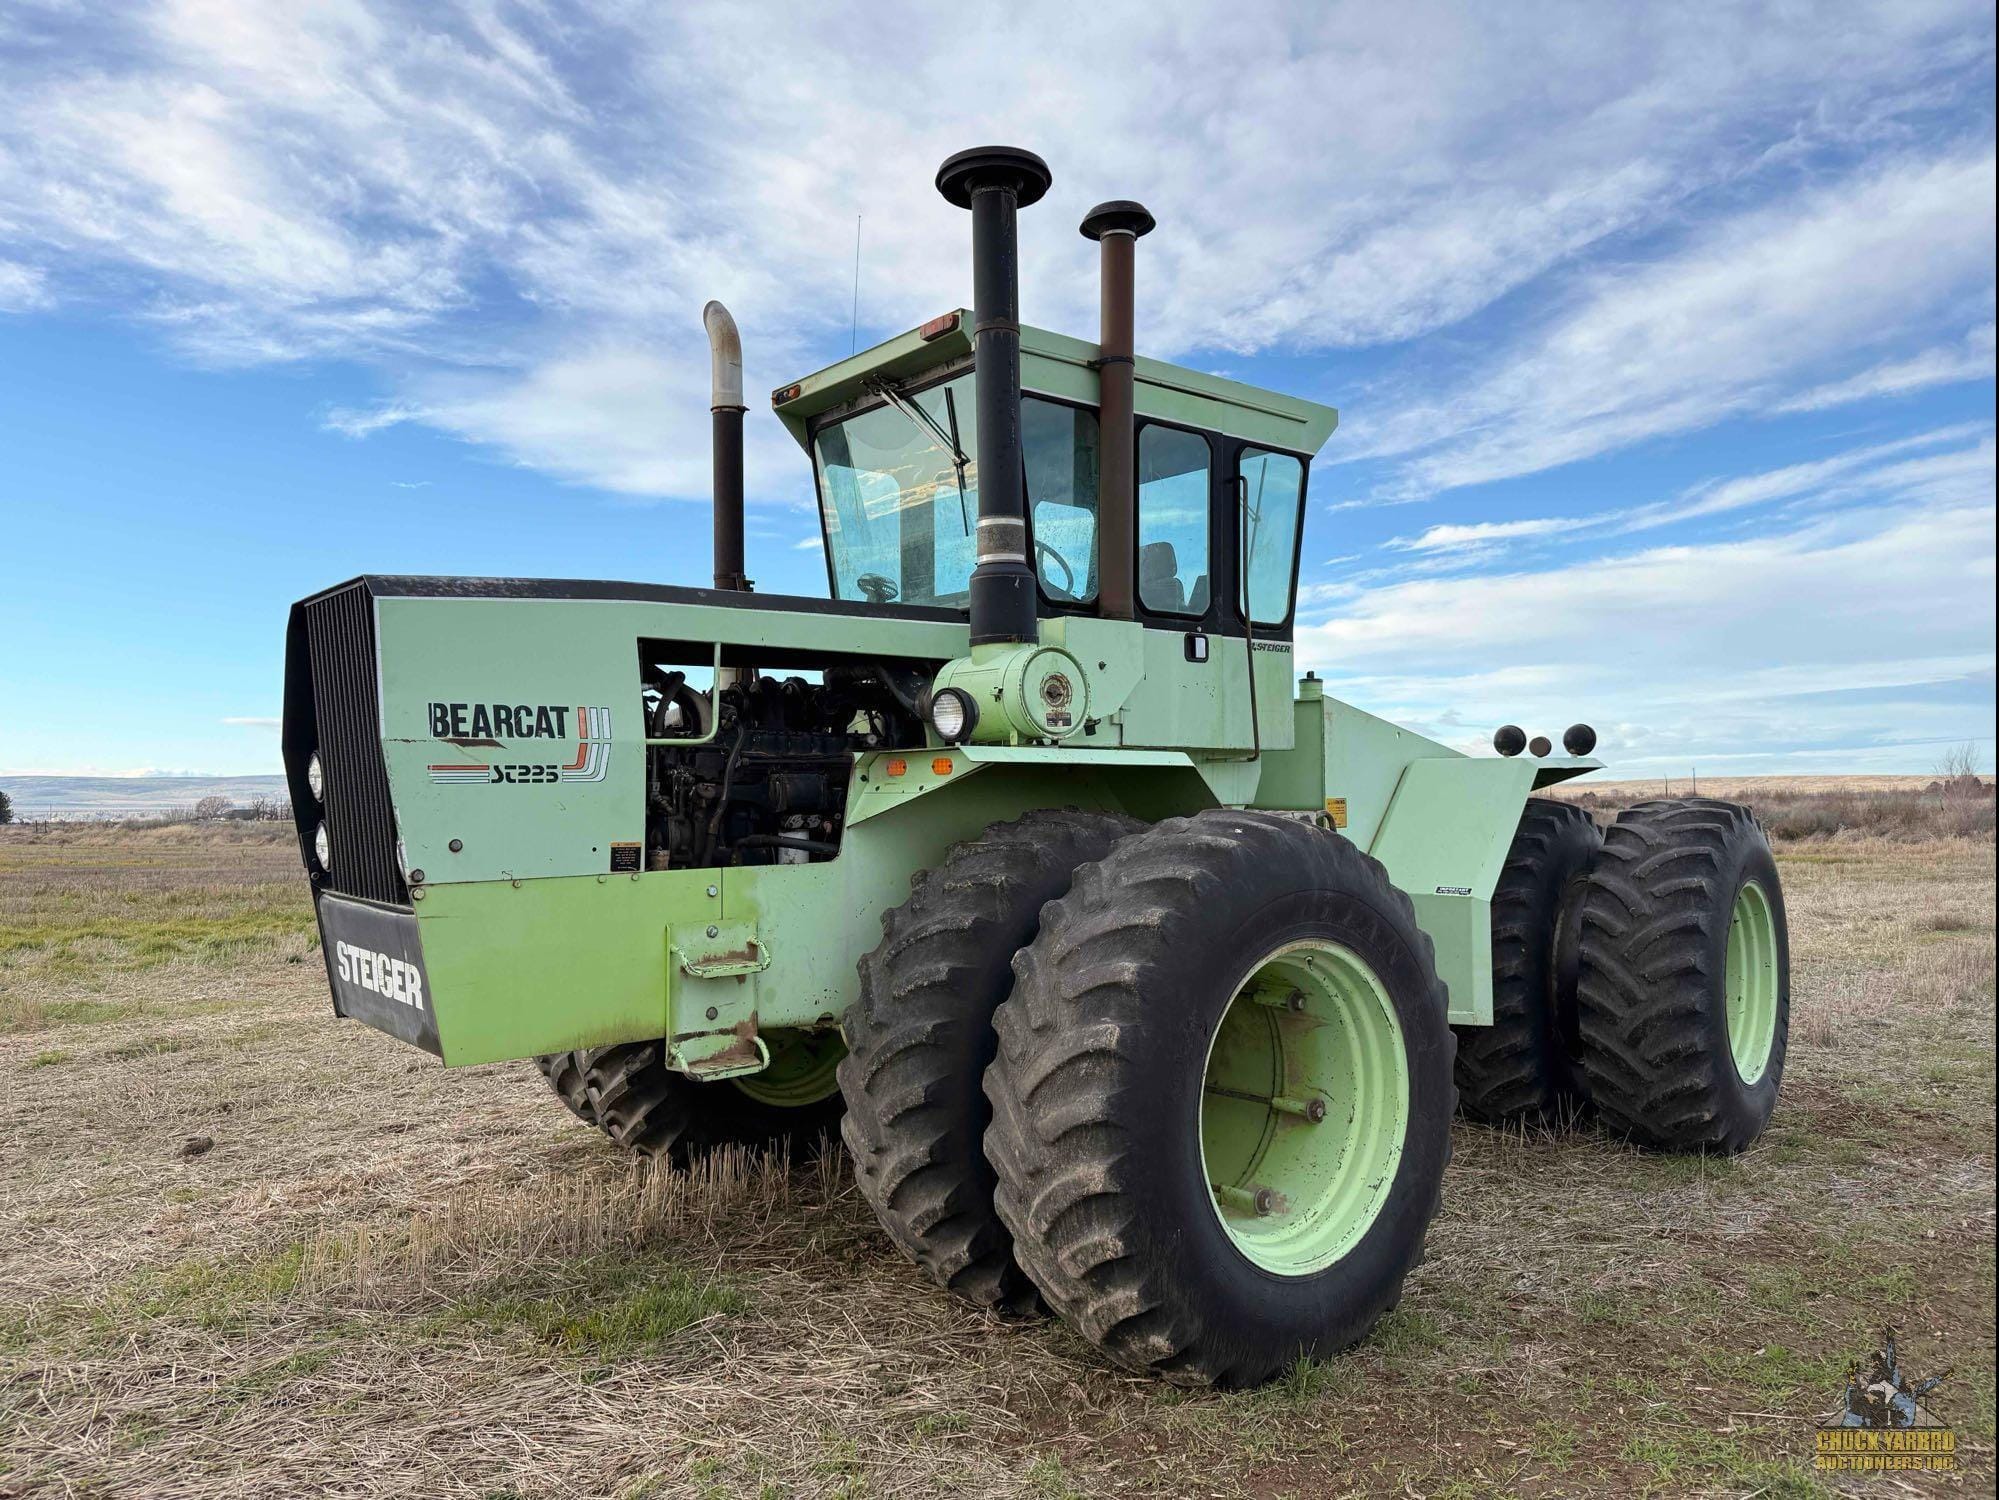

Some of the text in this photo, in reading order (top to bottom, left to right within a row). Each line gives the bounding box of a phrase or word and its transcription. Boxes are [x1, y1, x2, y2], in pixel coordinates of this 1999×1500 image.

[1256, 642, 1291, 653] STEIGER
[428, 703, 569, 739] BEARCAT
[491, 765, 559, 783] ST225
[336, 940, 424, 1011] STEIGER
